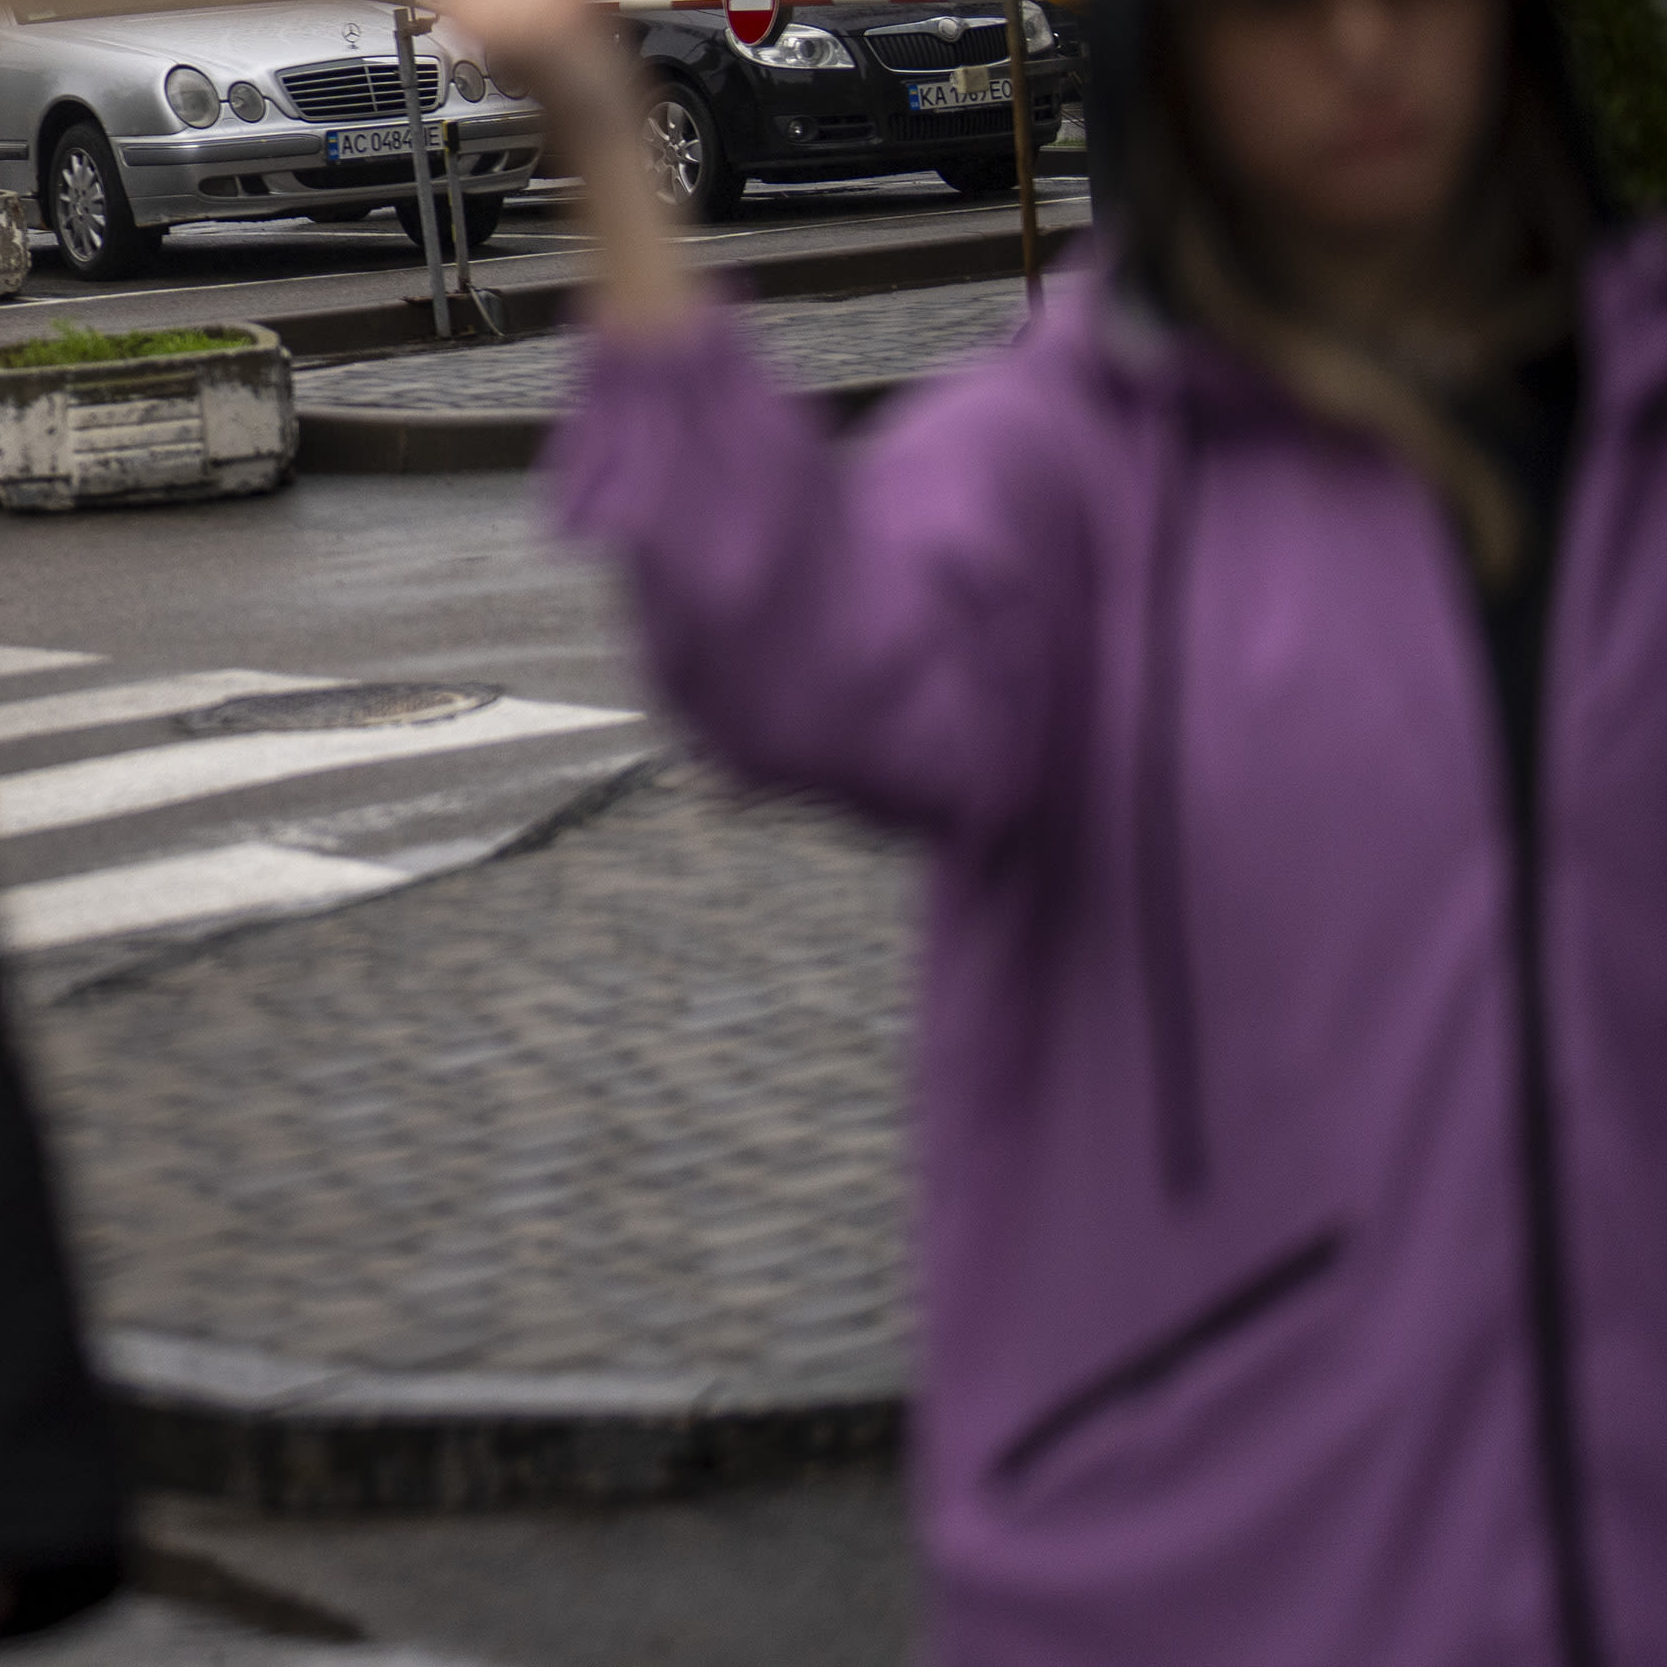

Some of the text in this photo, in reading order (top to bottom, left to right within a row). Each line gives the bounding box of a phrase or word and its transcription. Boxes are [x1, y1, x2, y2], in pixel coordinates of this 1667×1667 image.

[919, 86, 948, 107] KA
[989, 80, 1013, 100] EO
[342, 125, 441, 155] AC 0484 E
